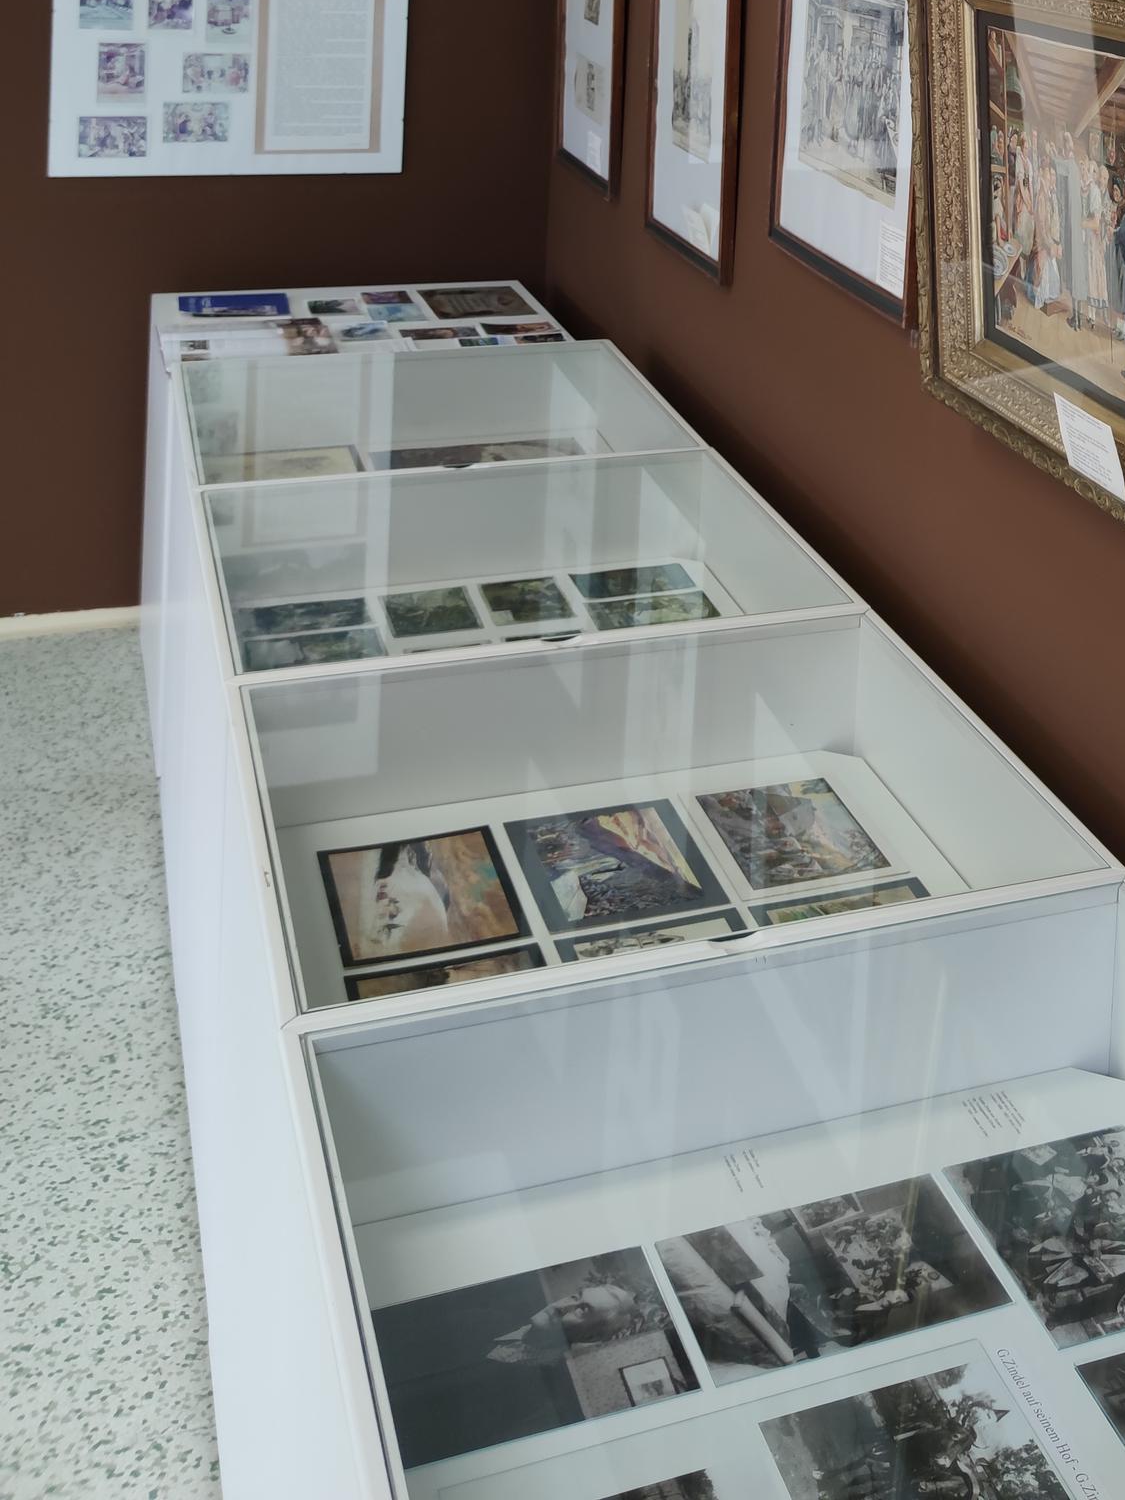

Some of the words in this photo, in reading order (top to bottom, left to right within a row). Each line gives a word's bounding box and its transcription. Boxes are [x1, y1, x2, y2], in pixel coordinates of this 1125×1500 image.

[996, 1348, 1031, 1390] G.Zindel
[1022, 1389, 1043, 1407] auf
[1033, 1407, 1061, 1443] seinem
[1056, 1443, 1079, 1465] Hof
